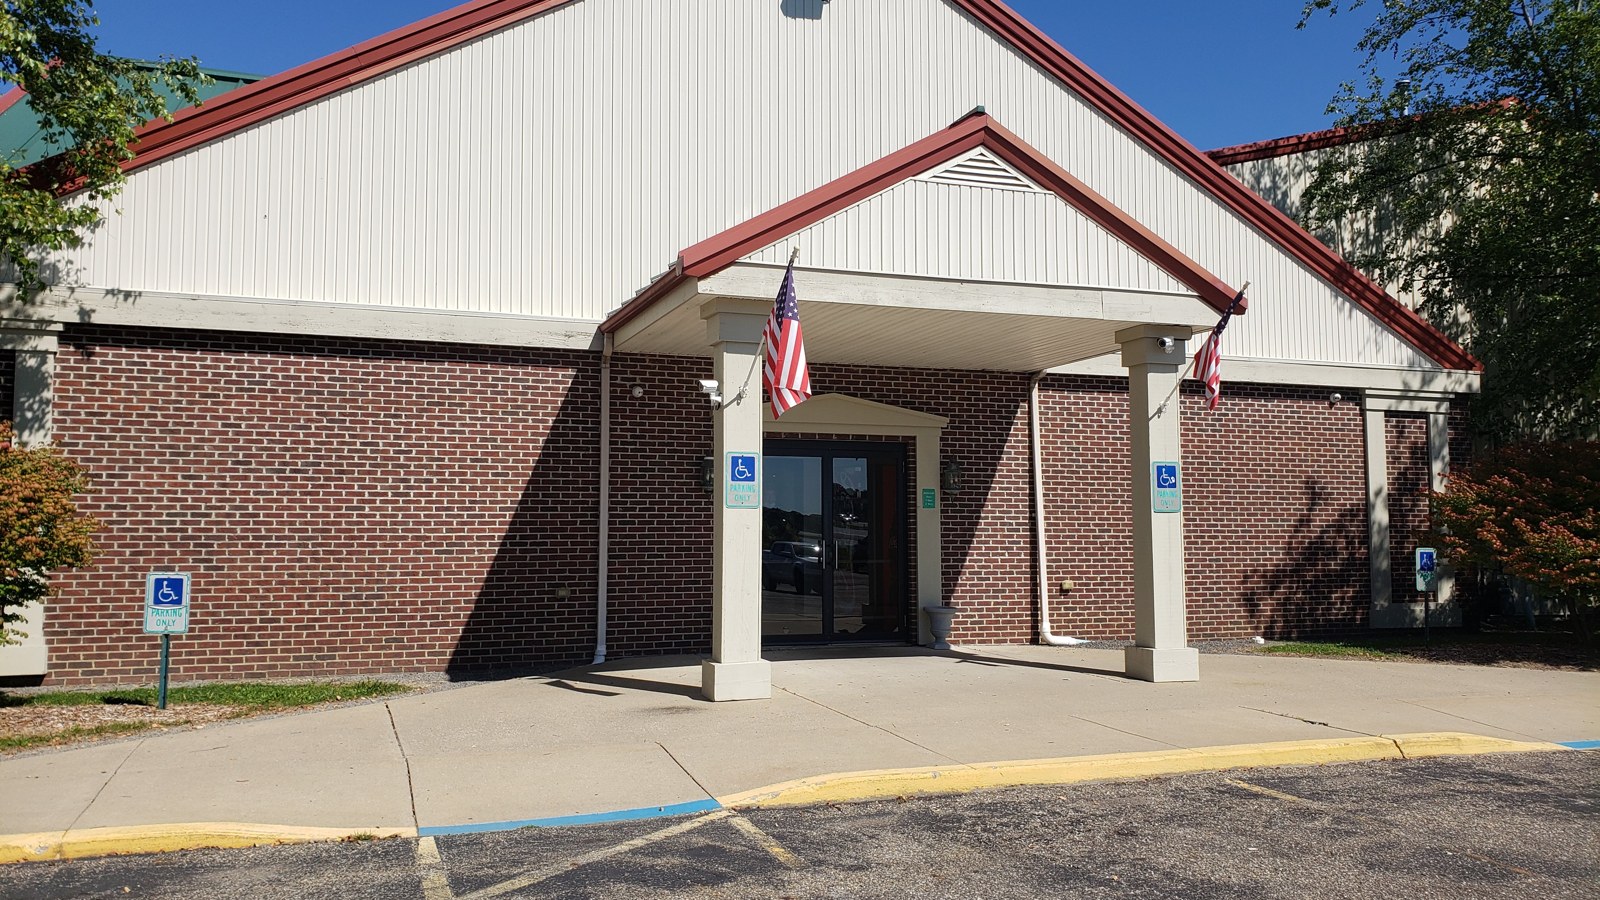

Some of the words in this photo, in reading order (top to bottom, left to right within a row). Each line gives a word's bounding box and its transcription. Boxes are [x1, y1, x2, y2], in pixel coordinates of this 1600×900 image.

[730, 484, 756, 493] PARKING
[734, 494, 751, 502] ONLY
[151, 609, 183, 618] PARKING
[155, 619, 177, 627] ONLY
